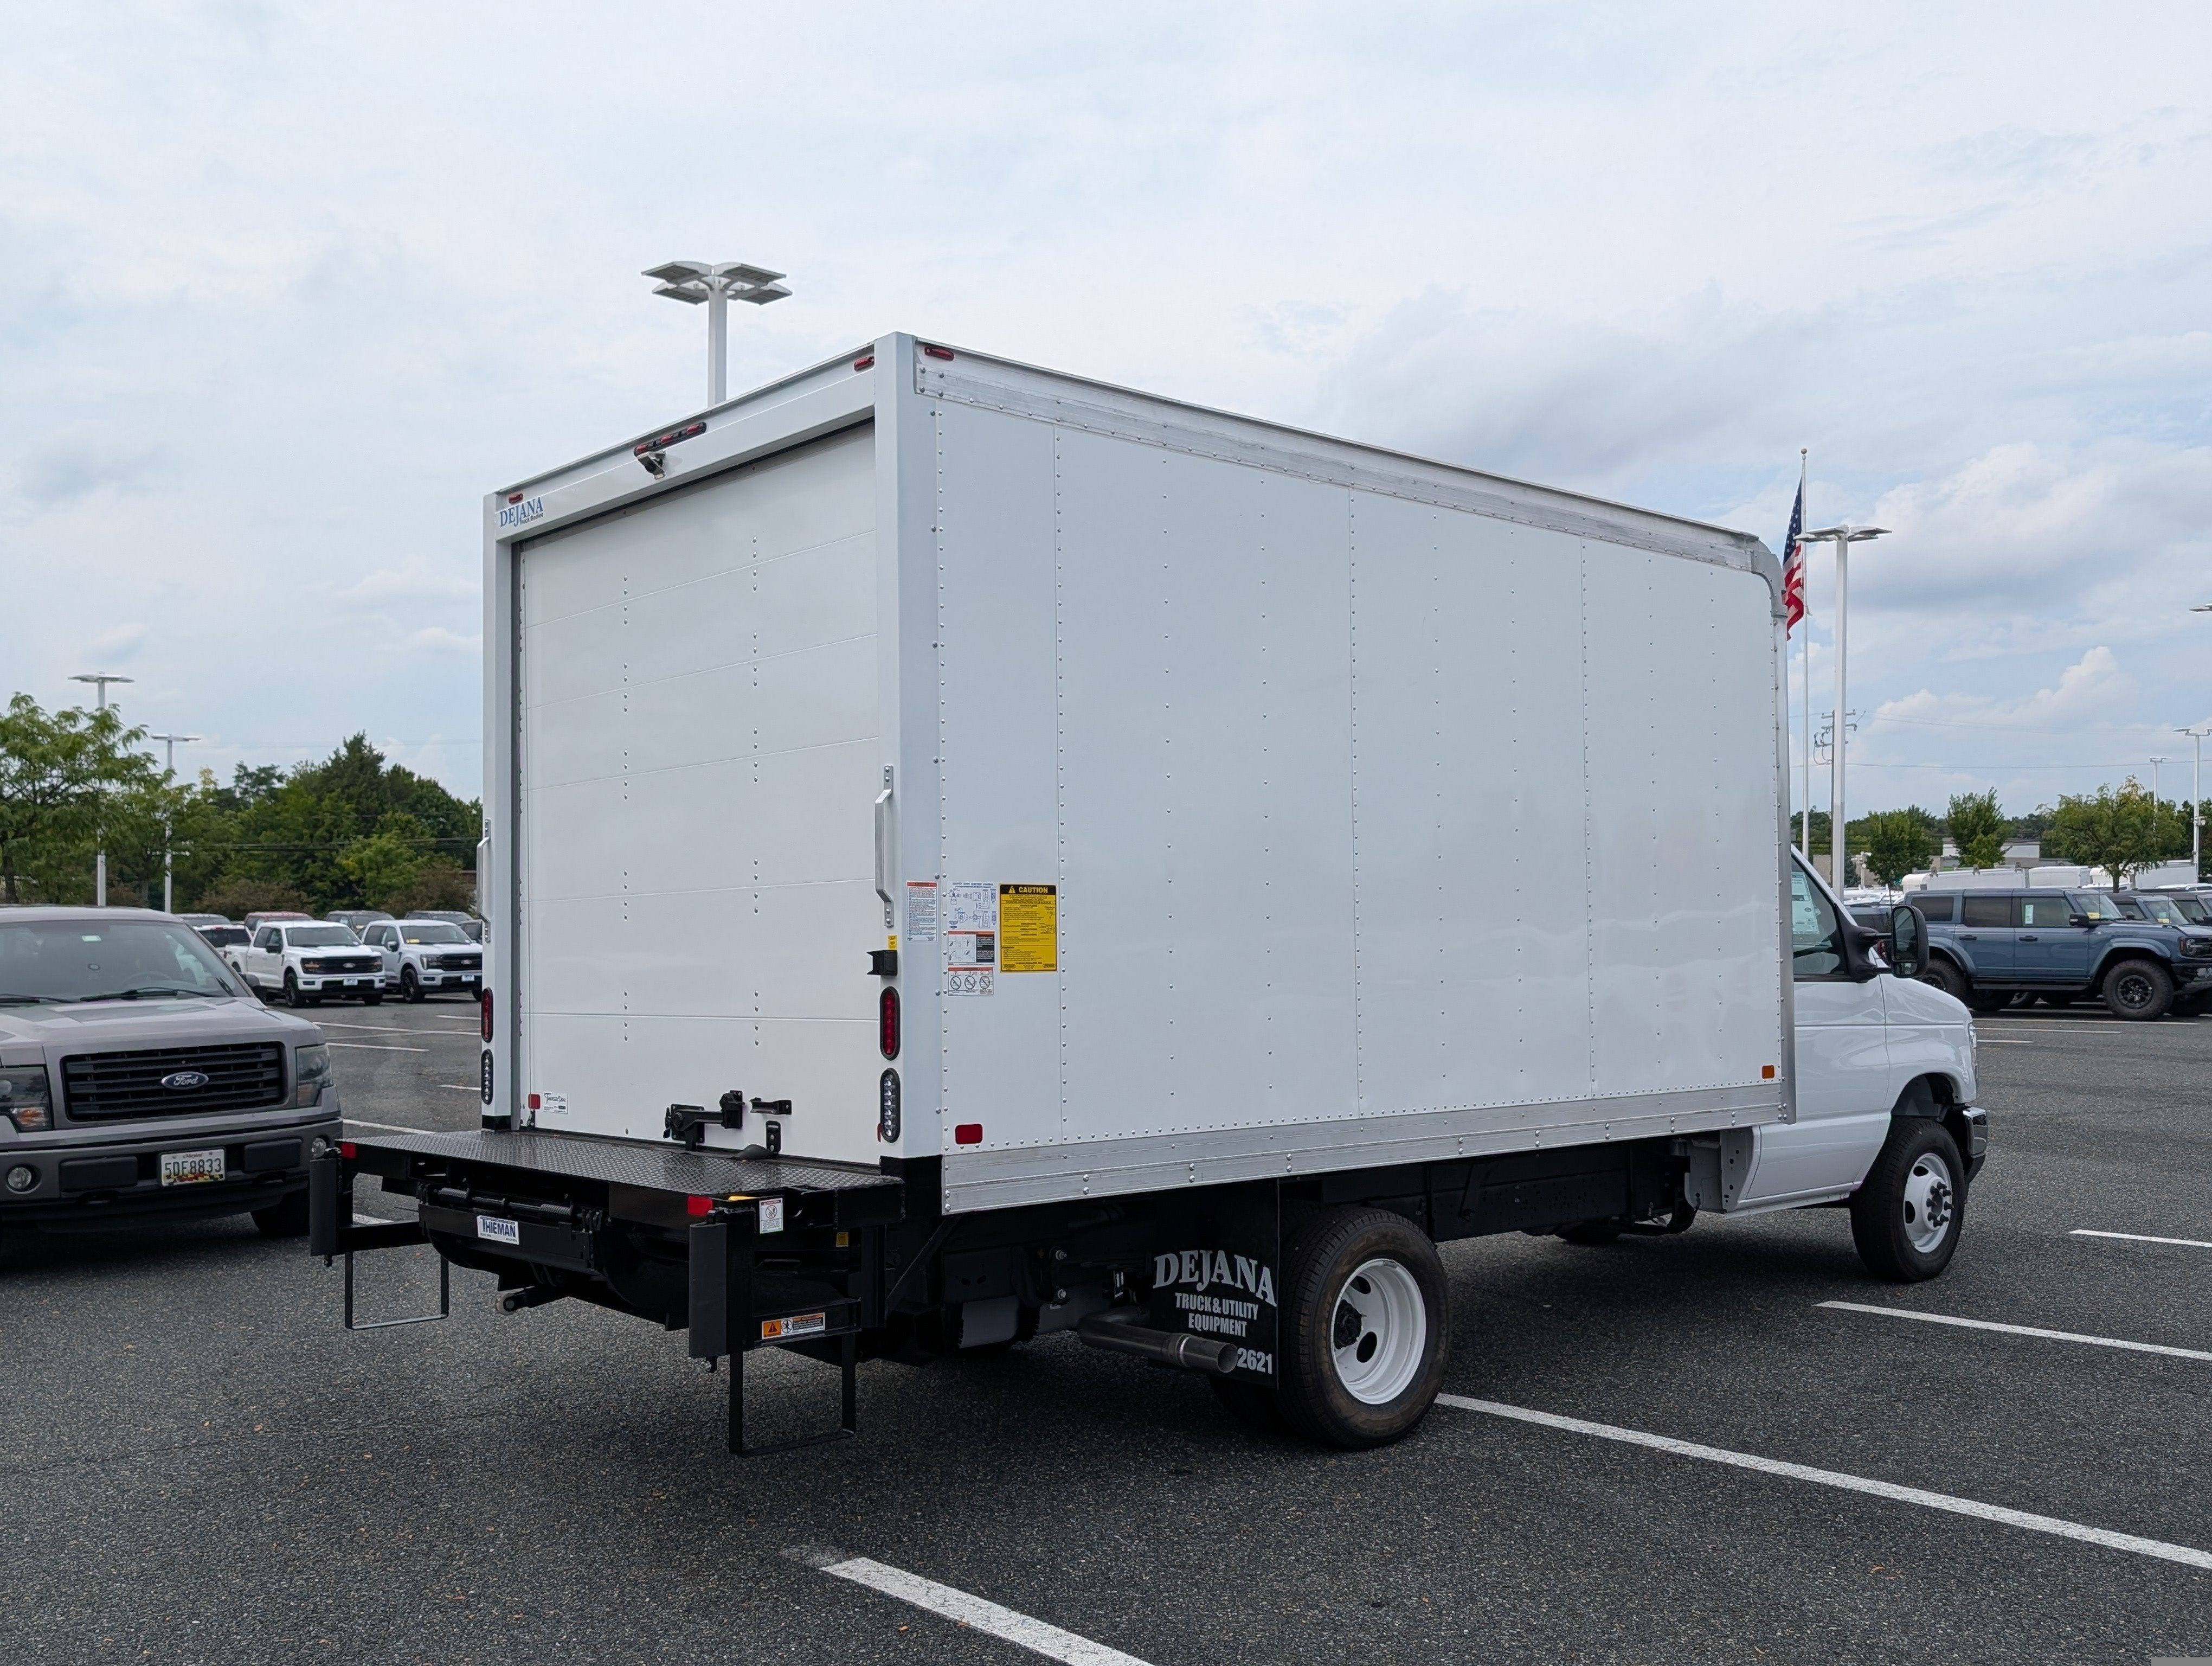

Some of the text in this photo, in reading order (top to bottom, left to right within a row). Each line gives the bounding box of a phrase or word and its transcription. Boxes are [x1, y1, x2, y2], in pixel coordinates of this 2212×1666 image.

[499, 497, 543, 527] DEJANA
[173, 1074, 198, 1085] Ford
[480, 1216, 516, 1237] THIEMAN
[1153, 1250, 1277, 1308] DEJANA
[1188, 1312, 1247, 1337] EQUIPMENT
[1237, 1348, 1272, 1375] 2621
